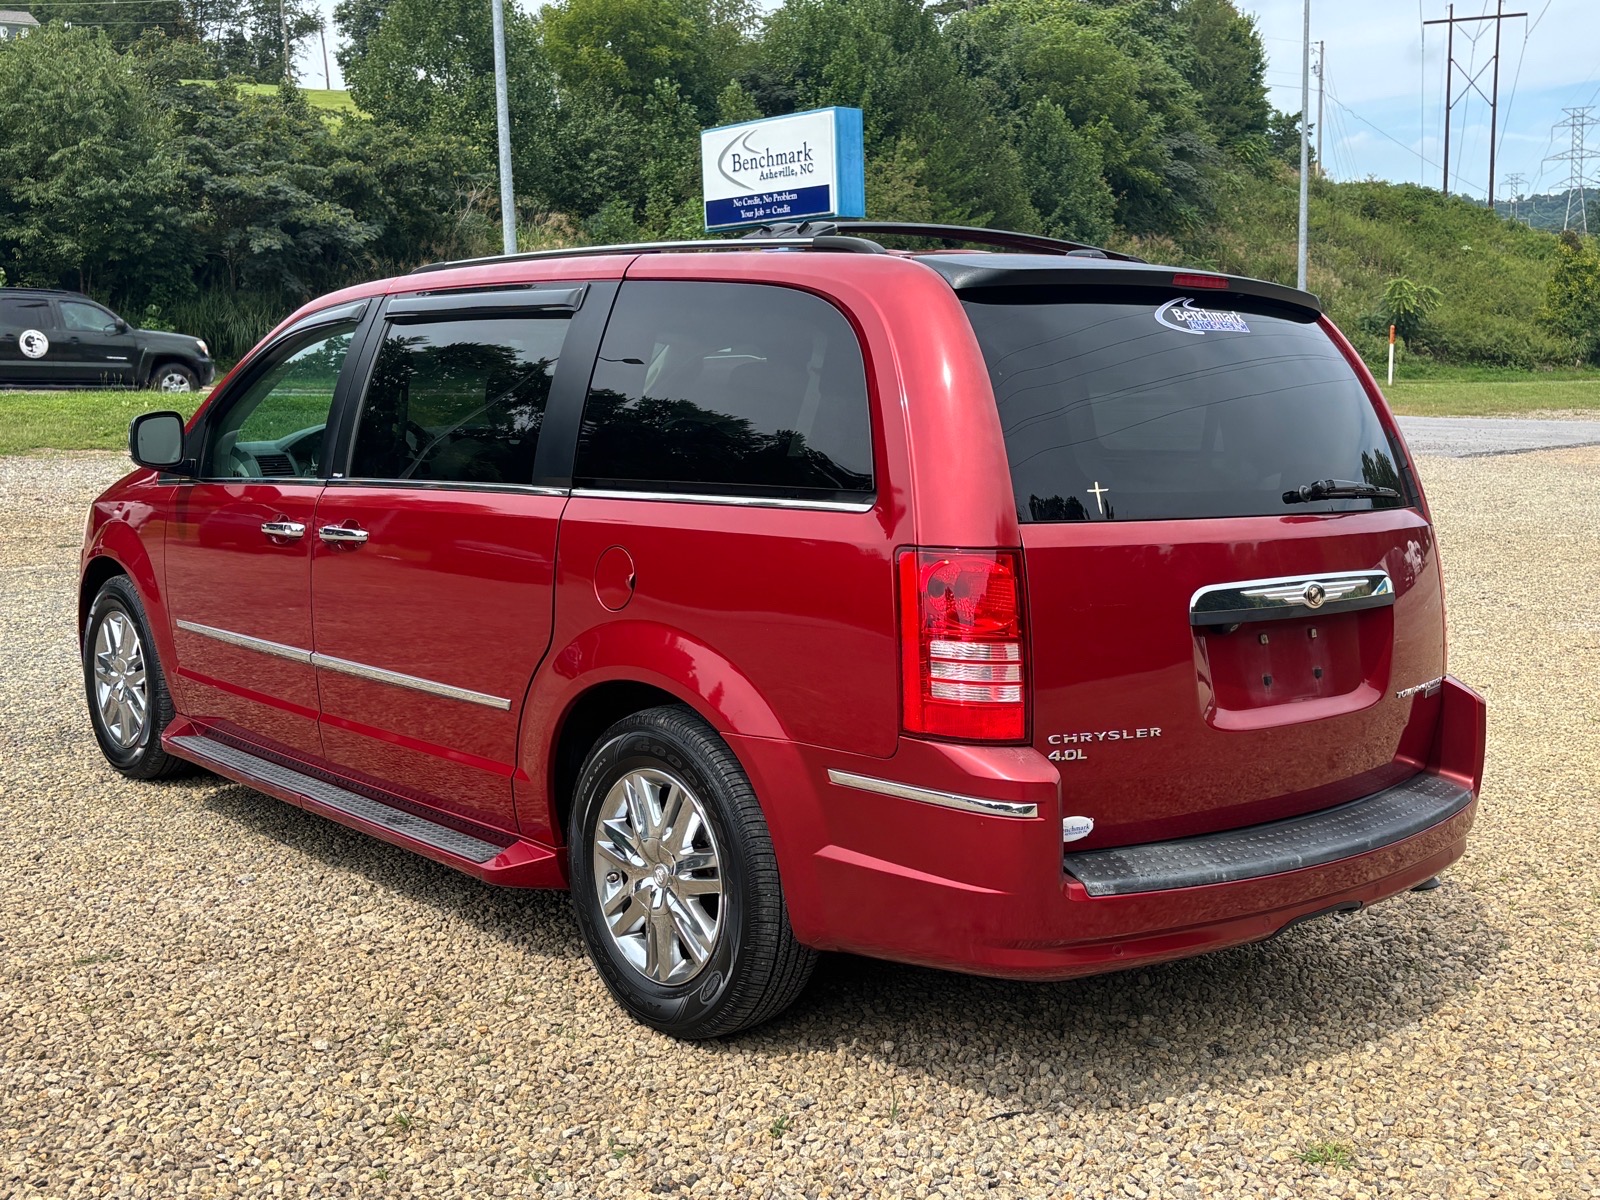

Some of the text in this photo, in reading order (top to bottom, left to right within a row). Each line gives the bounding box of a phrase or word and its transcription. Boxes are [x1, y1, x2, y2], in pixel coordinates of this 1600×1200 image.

[732, 141, 813, 172] Benchmark
[759, 162, 814, 181] Asheville, NC
[733, 199, 742, 207] No
[763, 194, 772, 204] No
[773, 192, 797, 202] Problem
[740, 209, 753, 218] Your
[754, 207, 764, 218] Job
[772, 204, 791, 214] Credit
[1171, 308, 1246, 324] Benchmark
[1192, 320, 1211, 329] AUTO
[1048, 727, 1162, 745] CHRYSLER
[1048, 749, 1088, 761] 4.0L
